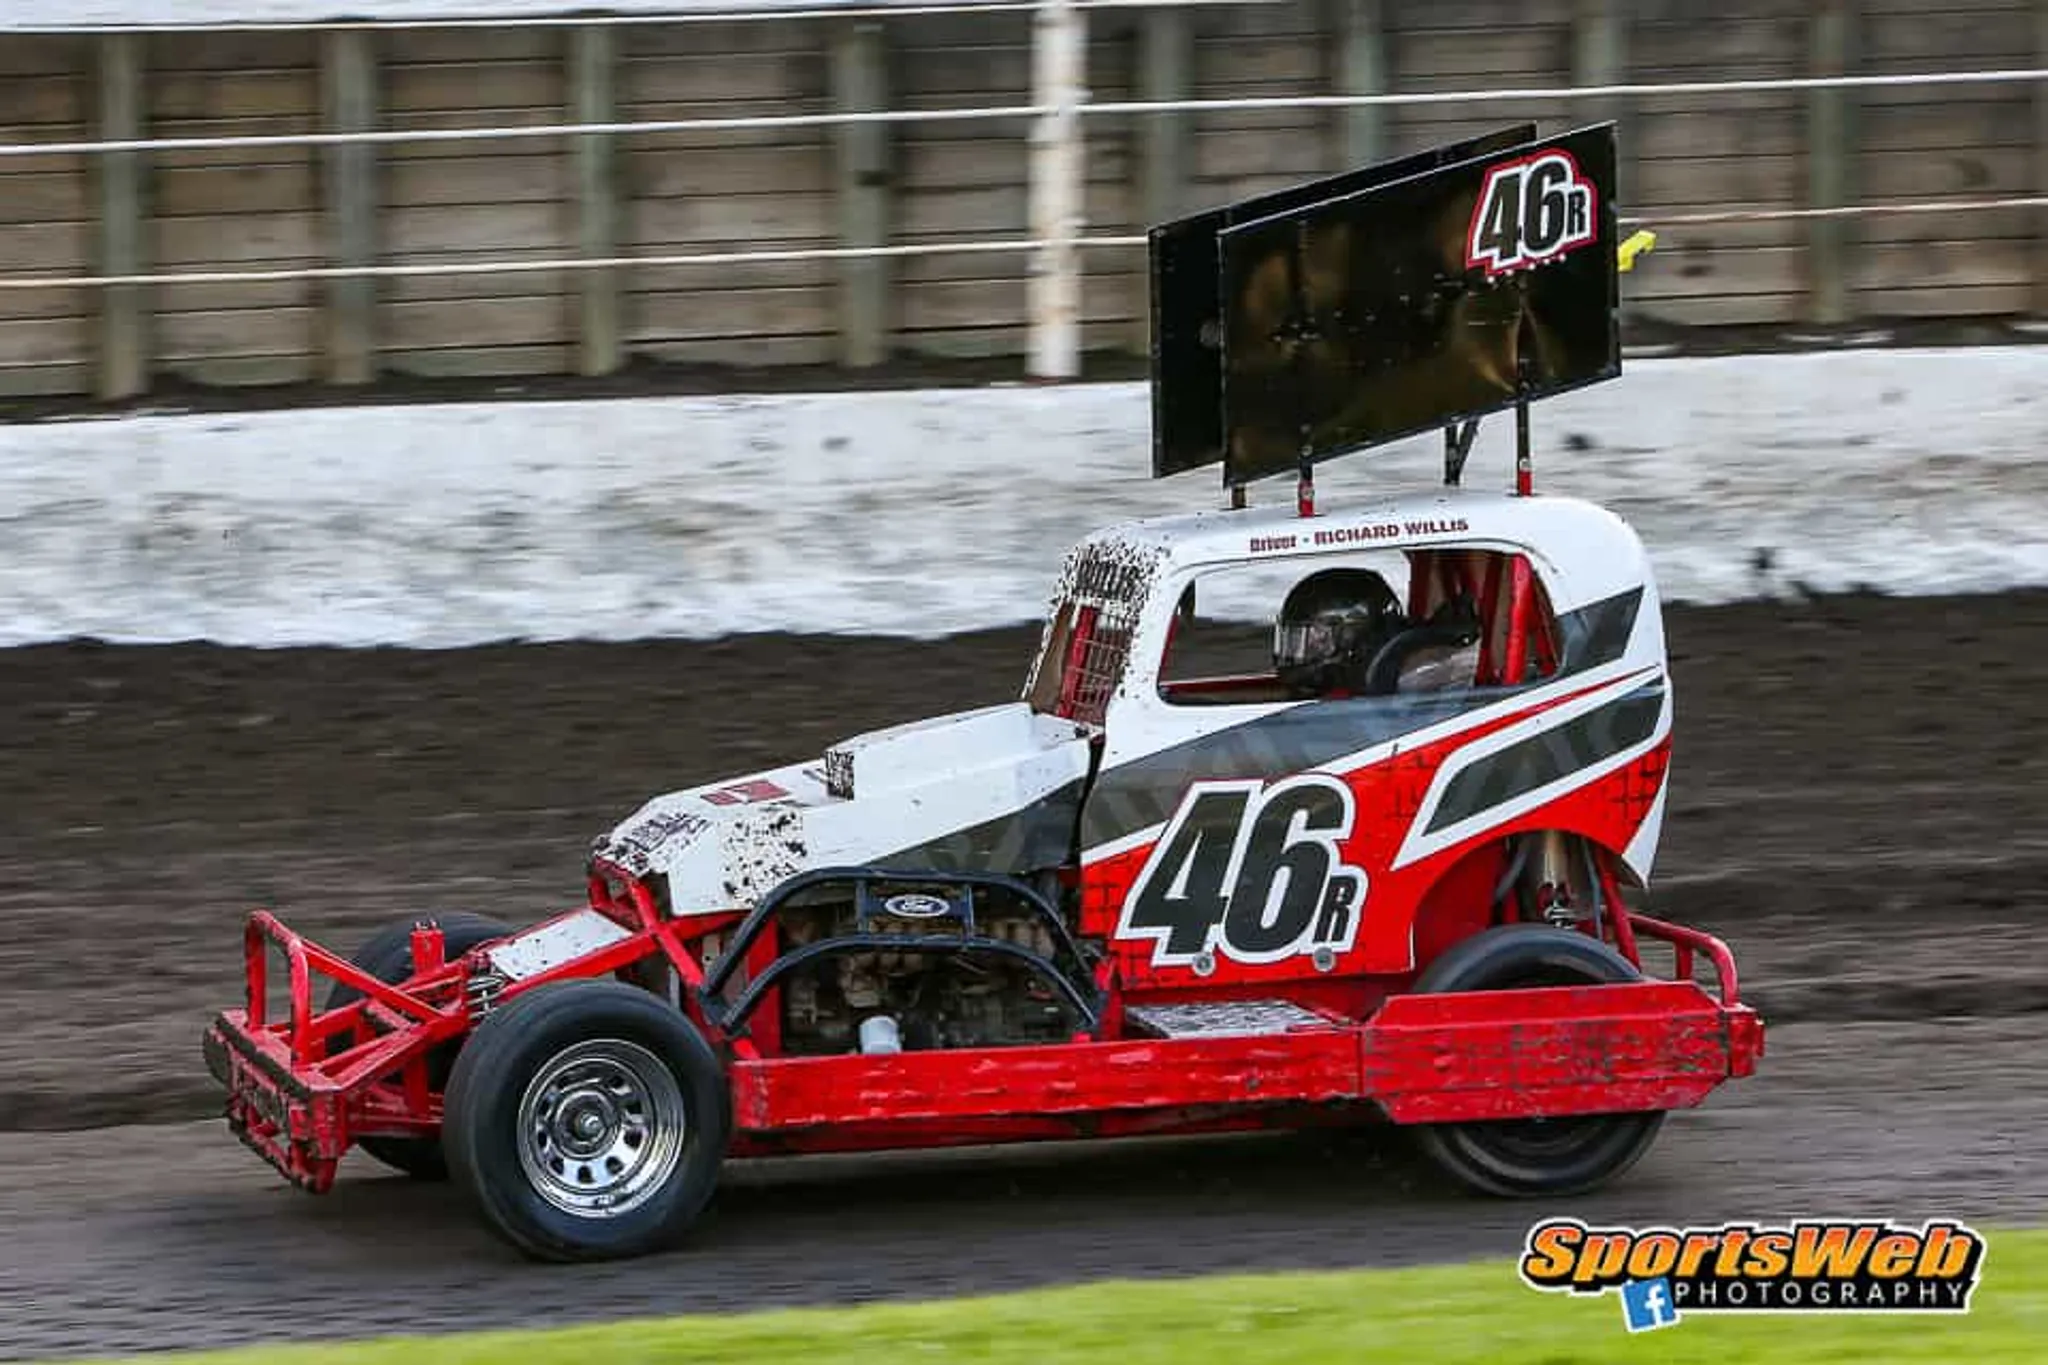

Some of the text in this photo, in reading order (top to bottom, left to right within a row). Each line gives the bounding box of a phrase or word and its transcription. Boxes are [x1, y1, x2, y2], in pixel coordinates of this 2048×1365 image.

[1477, 159, 1588, 262] 46R
[1313, 523, 1400, 546] RICHARD
[1404, 517, 1469, 535] WILLIS
[1127, 782, 1360, 957] 46R
